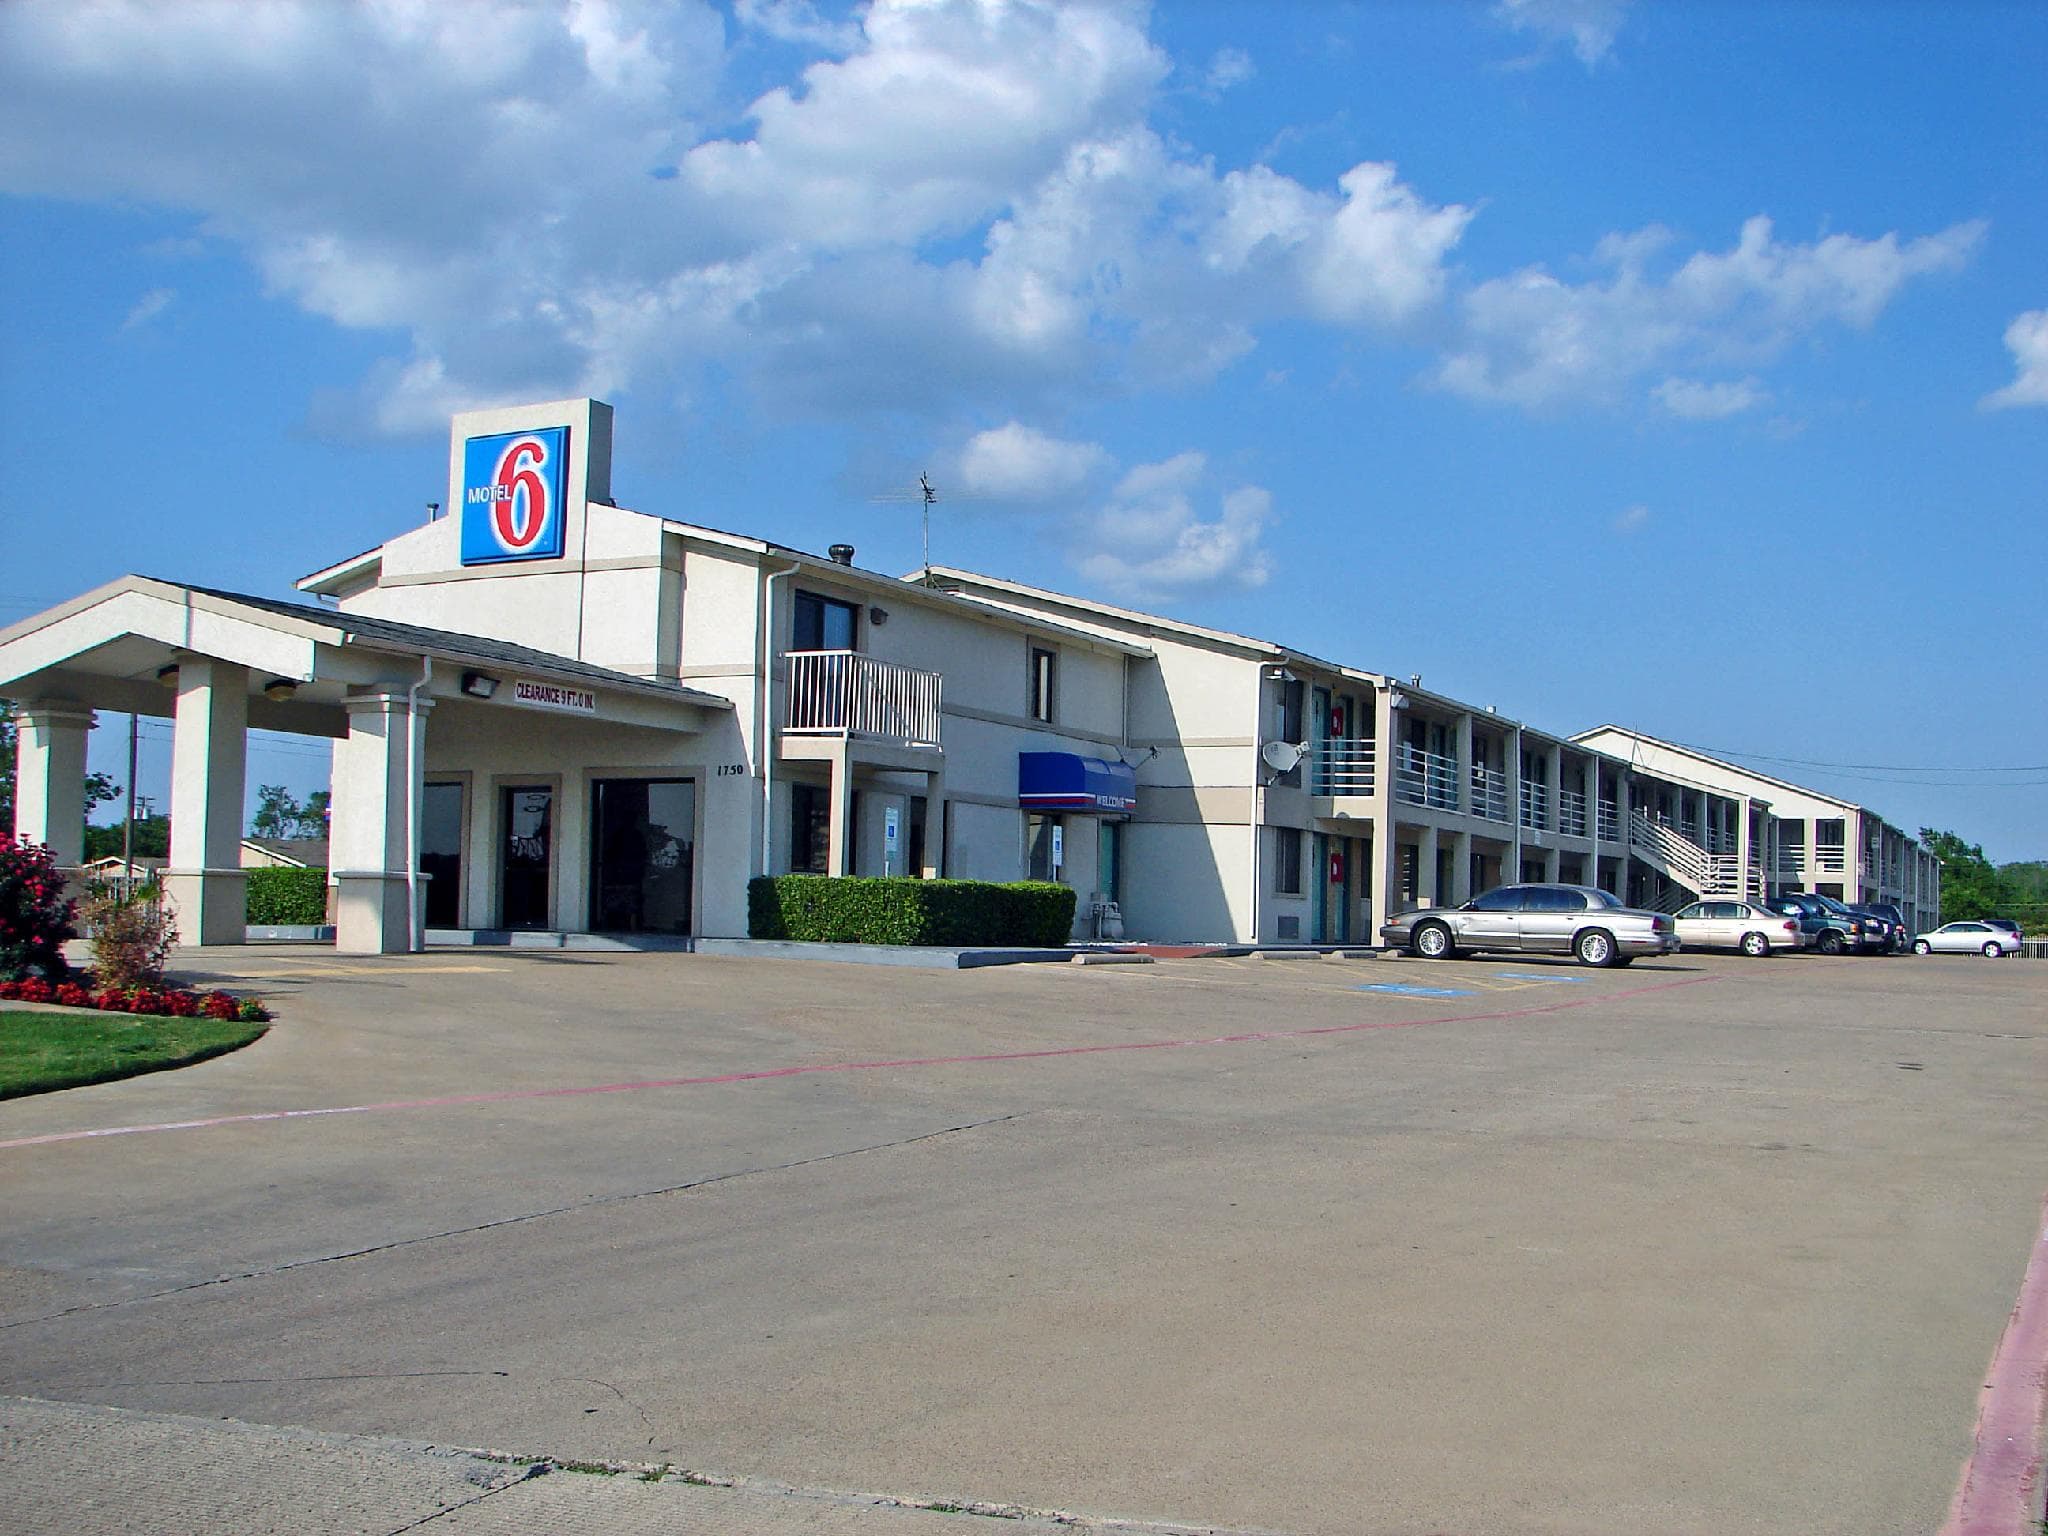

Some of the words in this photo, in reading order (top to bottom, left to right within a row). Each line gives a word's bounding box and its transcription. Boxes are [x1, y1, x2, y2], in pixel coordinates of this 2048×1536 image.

[468, 484, 512, 504] MOTEL
[494, 440, 546, 548] 6
[516, 682, 560, 704] CLEARANCE
[561, 690, 566, 704] 9
[579, 692, 584, 707] 0
[717, 765, 743, 776] 1750
[1096, 795, 1124, 808] WELCOME
